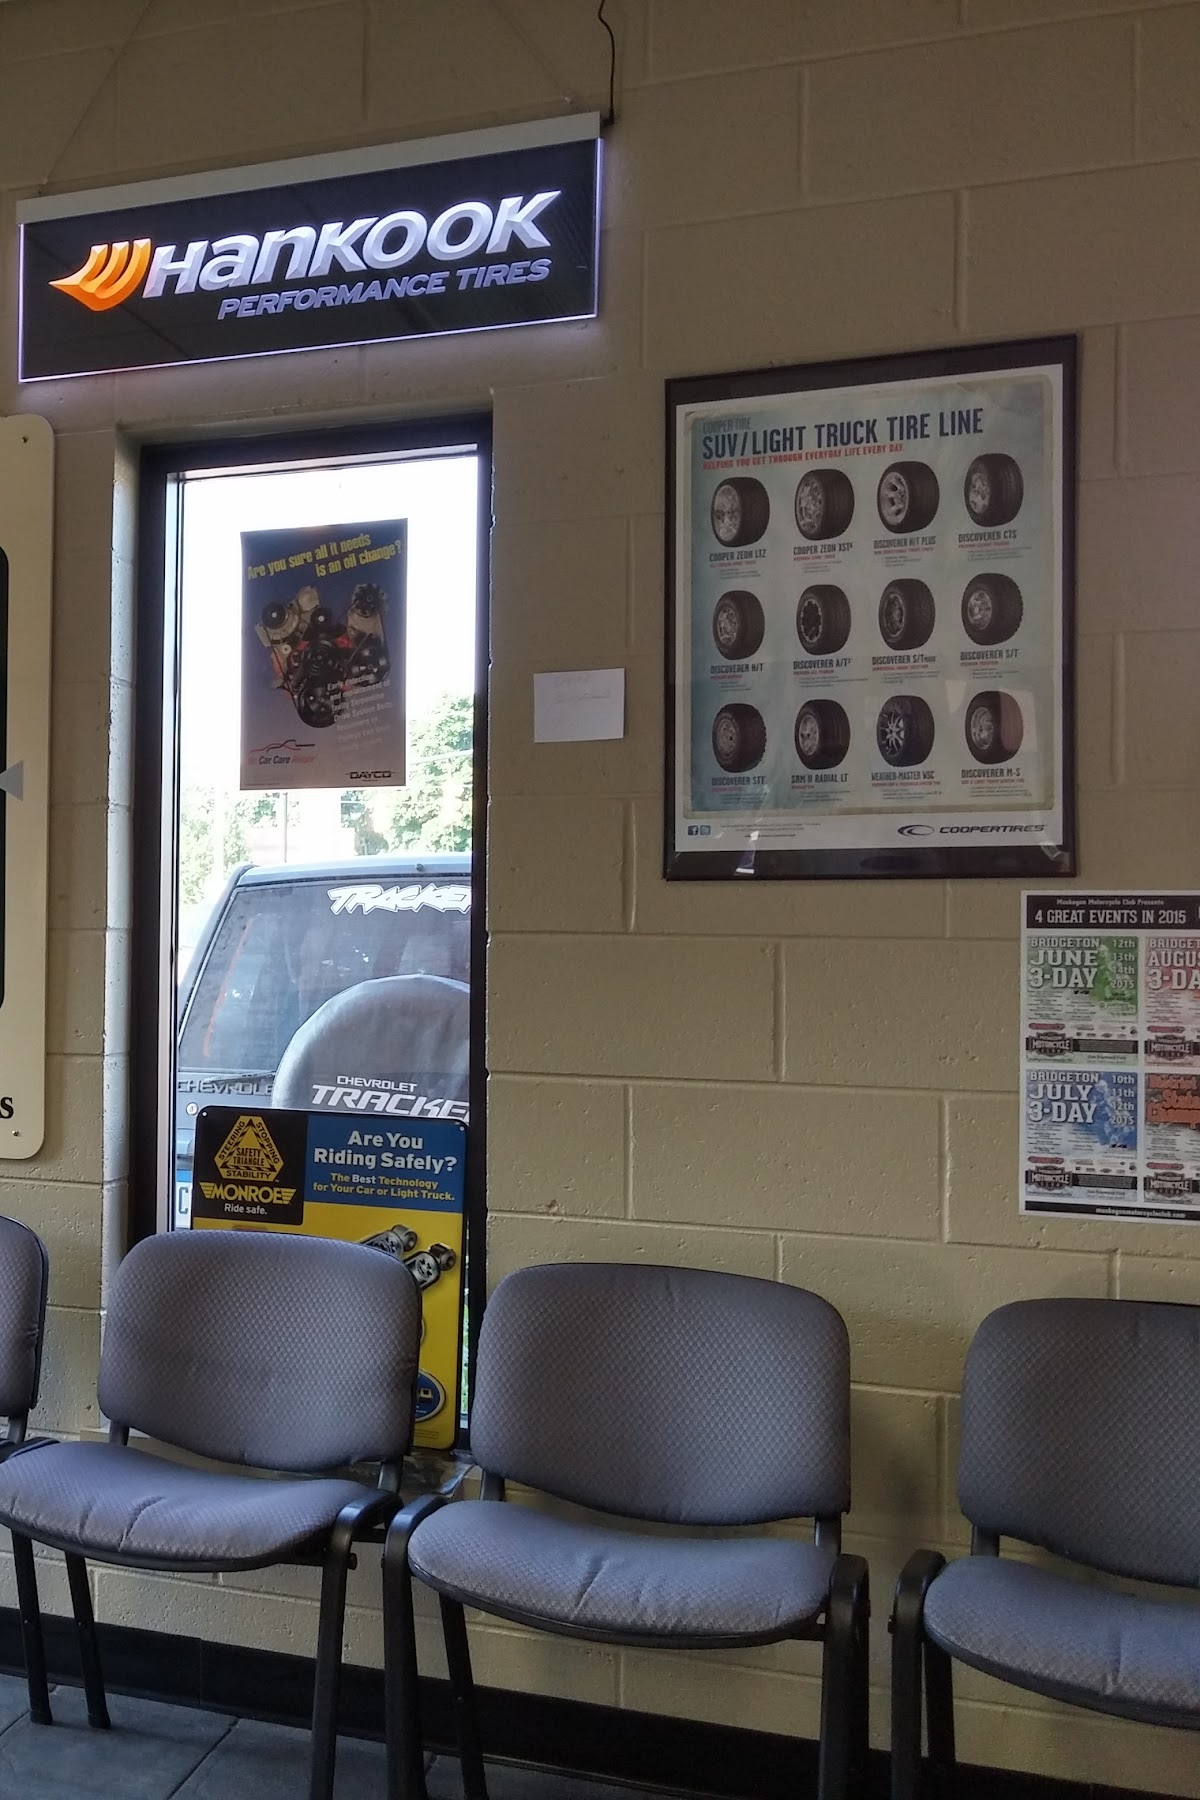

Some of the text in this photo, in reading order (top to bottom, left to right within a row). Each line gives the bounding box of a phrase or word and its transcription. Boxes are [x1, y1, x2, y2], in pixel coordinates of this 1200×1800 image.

[217, 258, 552, 320] PERFORMANCE TIRES
[814, 419, 878, 448] TRUCK
[888, 413, 931, 442] TIRE
[939, 408, 984, 435] LINE
[805, 447, 841, 461] EVERYDAY
[844, 446, 861, 458] LIFE
[863, 444, 887, 456] EVERY
[921, 535, 936, 545] PLUS
[958, 531, 1000, 544] DISCOVERER
[247, 533, 371, 580] Are you sure all it needs
[709, 550, 734, 563] COOPER
[794, 544, 818, 556] COOPER
[316, 540, 402, 577] is an oil change?
[872, 654, 909, 665] DISCOVERER
[961, 650, 1004, 661] DISCOVERER
[711, 664, 750, 675] DISCOVERER
[793, 659, 833, 670] DISCOVERER
[259, 755, 272, 766] Car
[273, 754, 291, 764] Care
[349, 770, 392, 780] DAYCO
[791, 773, 805, 784] SRM
[961, 768, 1004, 779] DISCOVERER
[1035, 910, 1186, 924] 4 GREAT EVENTS IN 2015
[1030, 937, 1135, 948] BRIDGETON 12th
[1030, 950, 1135, 966] JUNE 13th
[1029, 966, 1135, 988] 3-DAY 14th
[1110, 980, 1135, 989] 2015
[337, 1075, 417, 1092] CHEVROLET
[1030, 1072, 1135, 1084] BRIDGETON 10th
[178, 1080, 274, 1096] CHEVROLE
[1030, 1084, 1135, 1101] JULY 11th
[312, 1084, 470, 1119] TRACKE
[1029, 1101, 1134, 1123] 3-DAY 12th
[1110, 1115, 1134, 1124] 2015
[218, 1120, 246, 1160] STEERING
[256, 1121, 280, 1164] STOPPING
[348, 1130, 424, 1151] Are You
[236, 1148, 261, 1157] SAFETY
[233, 1156, 265, 1166] TRIANGLE
[314, 1147, 458, 1173] Riding Safely?
[226, 1170, 271, 1179] STABILITY
[330, 1173, 439, 1190] The Best Technology
[210, 1184, 282, 1204] MONROE
[313, 1182, 455, 1201] for Your Car or Light Truck.
[224, 1203, 267, 1215] Ride safe.
